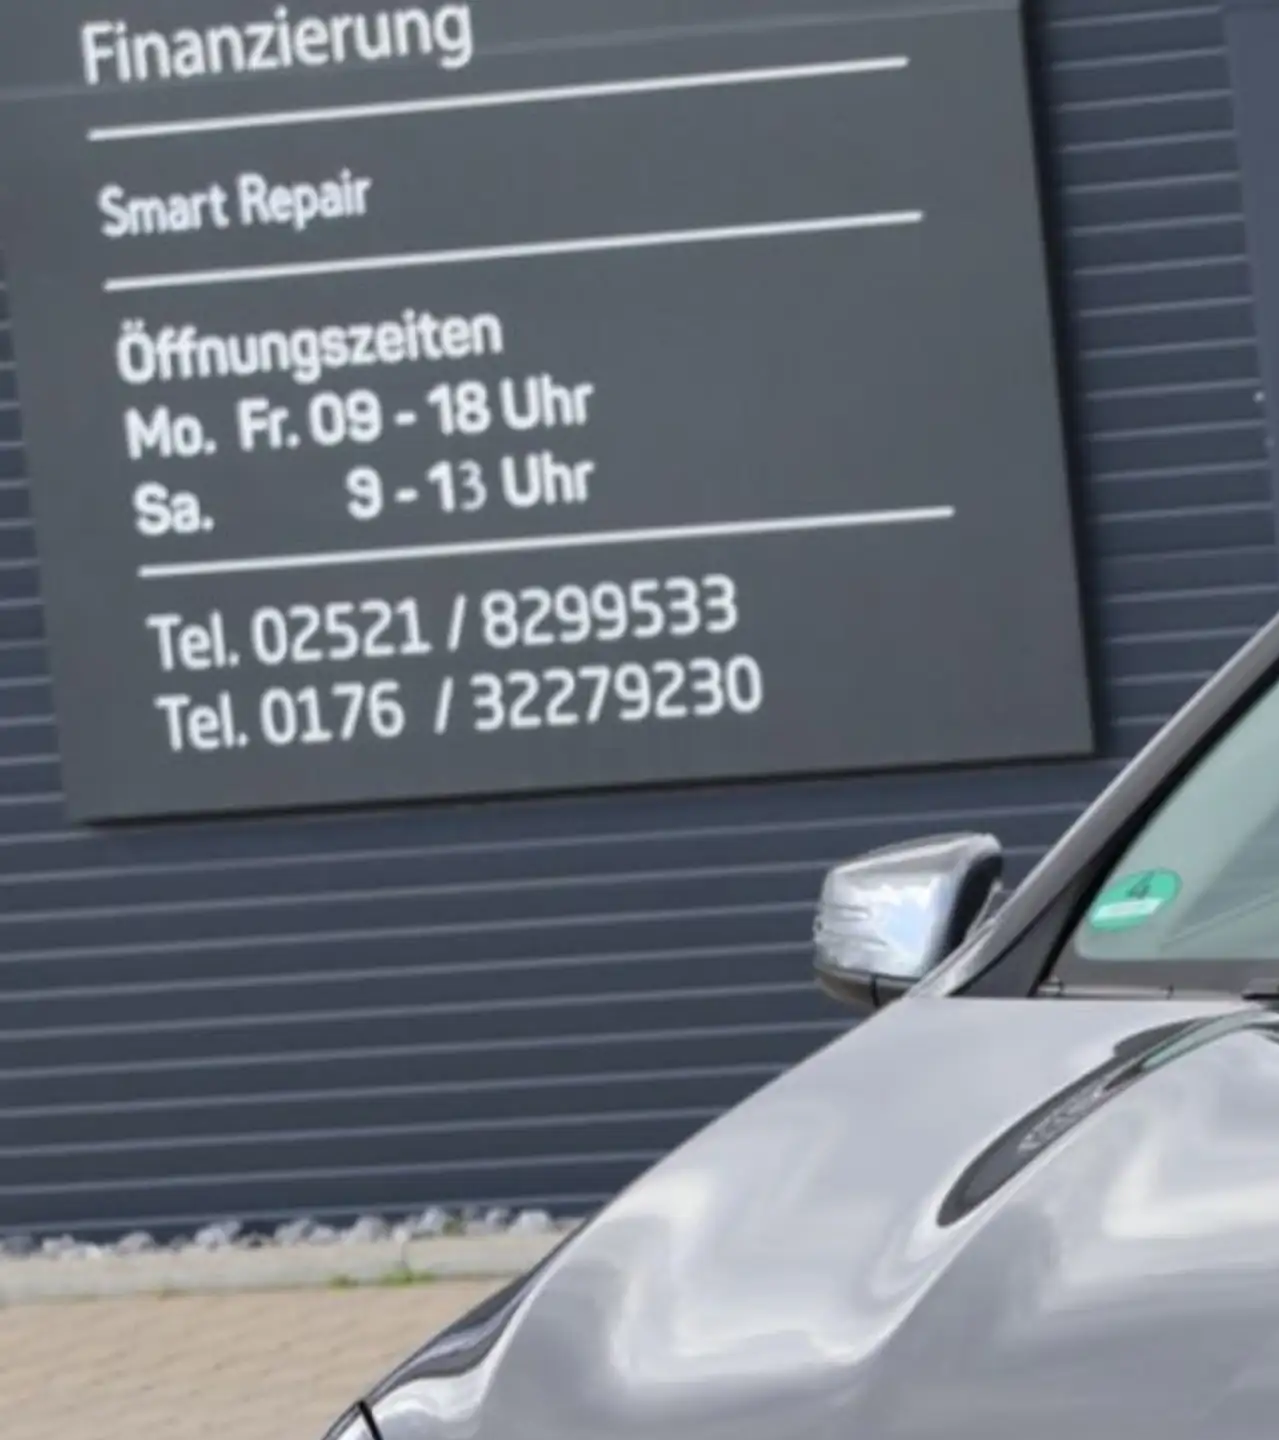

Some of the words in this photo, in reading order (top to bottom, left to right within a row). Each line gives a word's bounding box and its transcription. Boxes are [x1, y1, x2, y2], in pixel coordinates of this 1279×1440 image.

[80, 2, 474, 85] Finanzierung
[97, 183, 230, 239] Smart
[237, 167, 372, 232] Repair
[115, 307, 504, 386] Öffnungszeiten
[123, 405, 217, 461] Mo.
[236, 396, 300, 452] Fr.
[308, 387, 384, 447] 09
[427, 379, 493, 437] 18
[499, 372, 595, 431] Uhr
[132, 480, 215, 537] Sa.
[345, 465, 385, 521] 9
[427, 459, 488, 514] 13
[499, 449, 596, 509] Uhr
[145, 608, 241, 672] Tel.
[250, 597, 432, 666] 02521
[481, 572, 739, 650] 8299533
[154, 691, 248, 752] Tel.
[259, 679, 406, 746] 0176
[470, 654, 764, 732] 32279230
